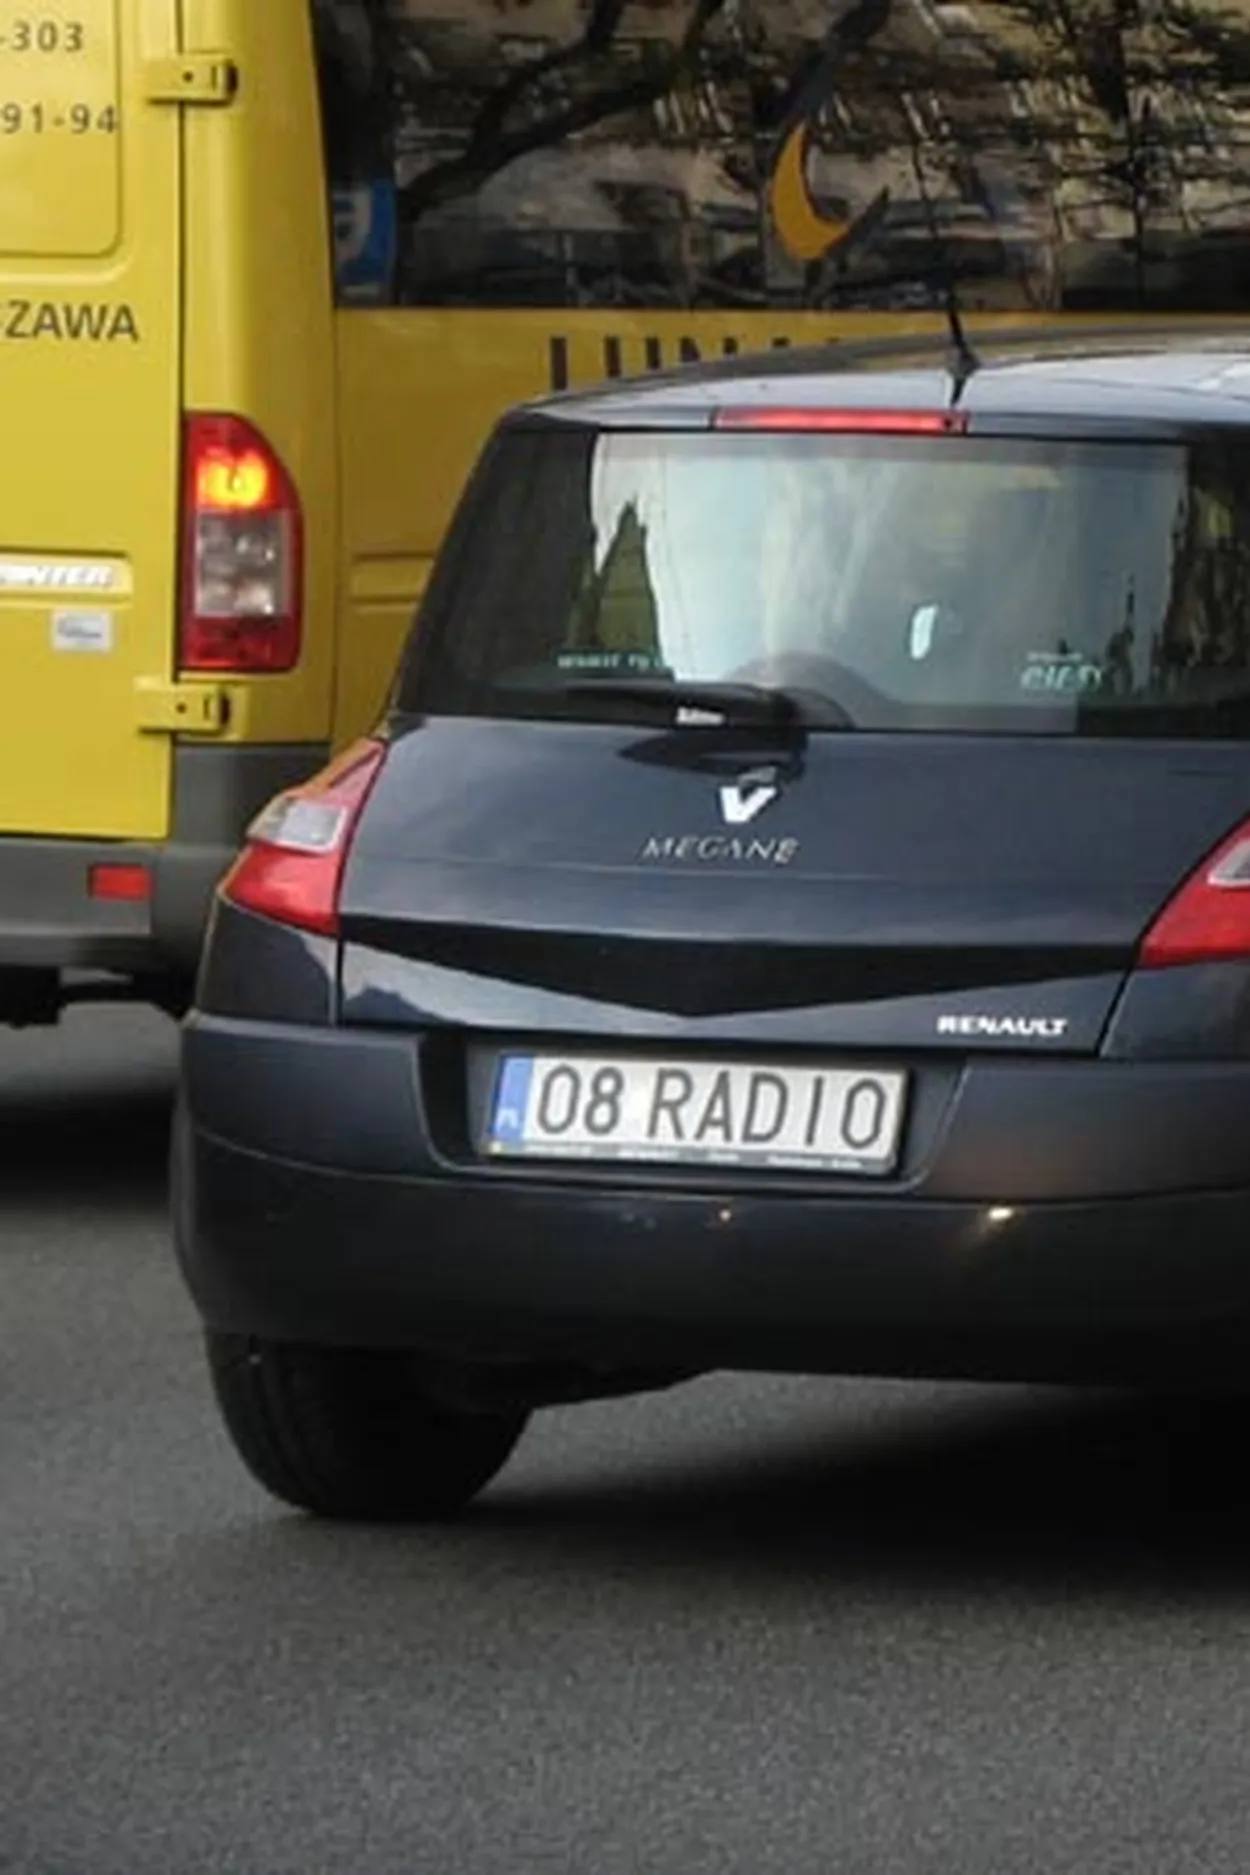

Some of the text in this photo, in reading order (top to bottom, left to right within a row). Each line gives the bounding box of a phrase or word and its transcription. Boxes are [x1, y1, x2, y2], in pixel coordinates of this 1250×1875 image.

[5, 299, 140, 343] ZAWA
[641, 836, 799, 865] MEGANE
[936, 1014, 1068, 1037] RENAULT
[536, 1063, 889, 1150] 08 RADIO
